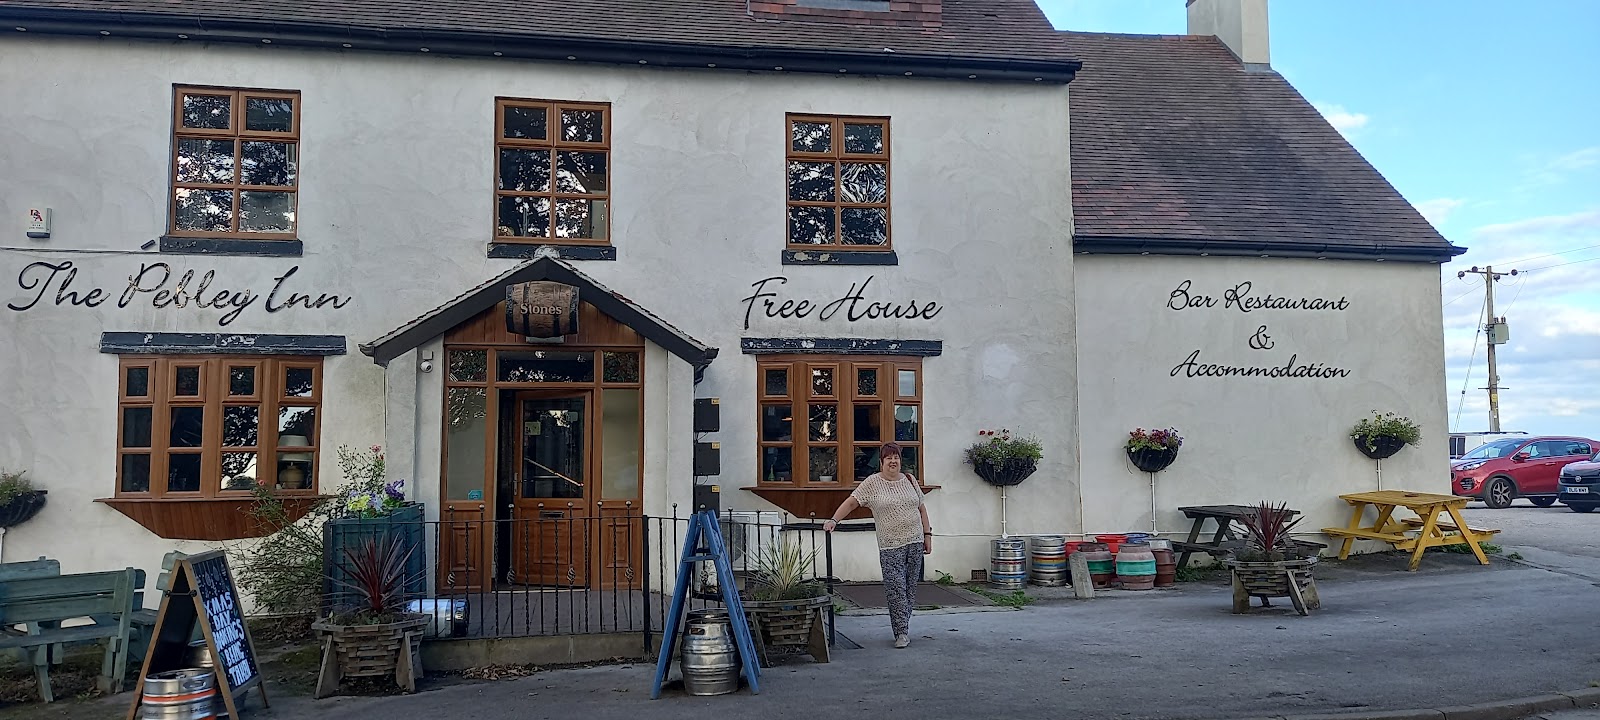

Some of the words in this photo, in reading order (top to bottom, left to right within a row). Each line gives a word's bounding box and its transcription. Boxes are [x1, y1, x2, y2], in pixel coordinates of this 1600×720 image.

[8, 260, 111, 312] The
[118, 261, 259, 327] Pebley
[264, 265, 352, 314] Inn
[741, 276, 816, 330] Free
[819, 275, 944, 322] House
[1166, 279, 1218, 311] Bar
[1224, 281, 1350, 313] Restaurant
[520, 302, 562, 316] Stones
[1248, 325, 1275, 350] &
[1170, 349, 1351, 379] Accommodation
[204, 591, 234, 619] XMAS
[213, 610, 231, 631] DAY
